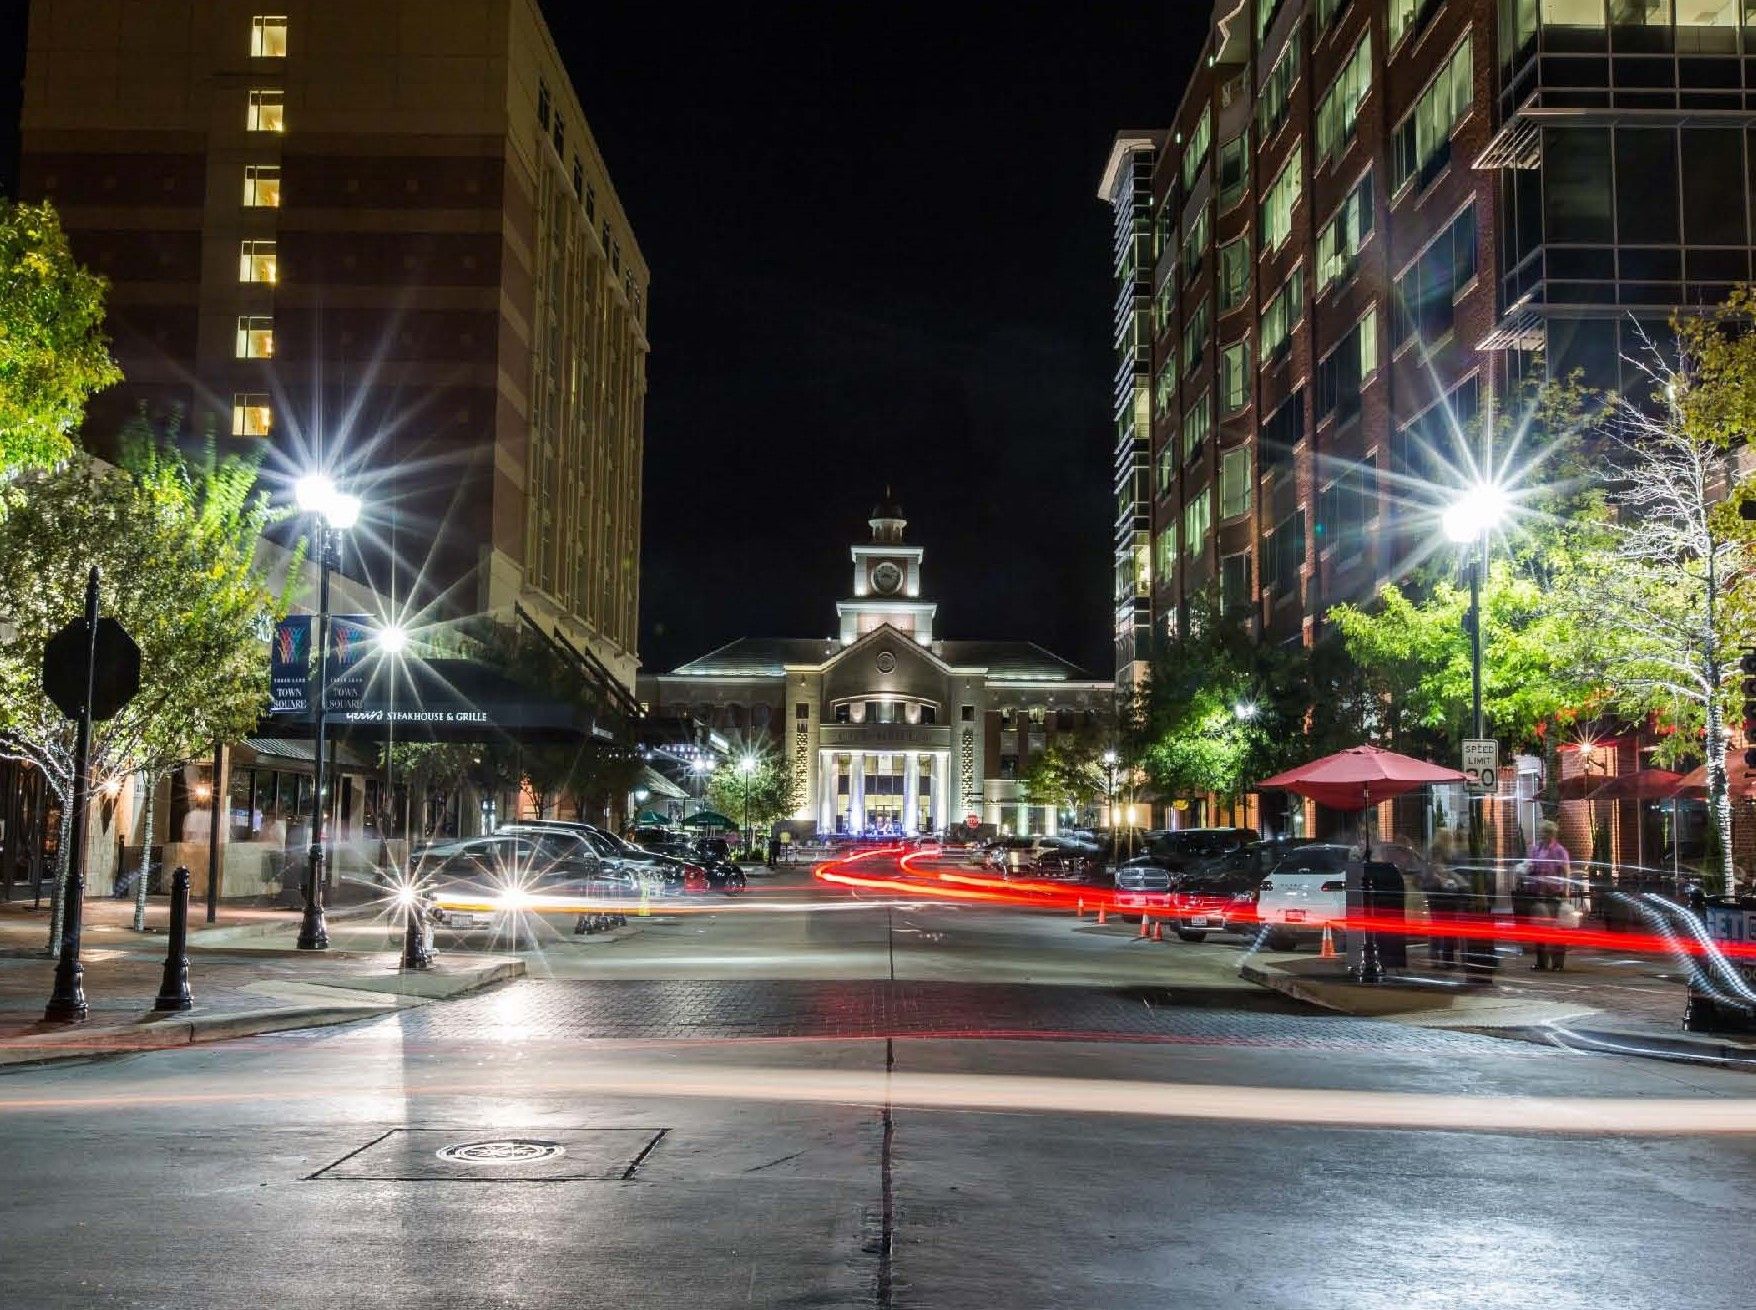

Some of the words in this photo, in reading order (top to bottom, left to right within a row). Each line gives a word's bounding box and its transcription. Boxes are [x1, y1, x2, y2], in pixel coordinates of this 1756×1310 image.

[276, 688, 302, 698] TOWN
[386, 712, 444, 722] STEAKHOUSE
[446, 712, 454, 721] &
[455, 712, 487, 722] GRILLE
[1465, 745, 1494, 754] SPEED
[1468, 757, 1491, 765] LIMIT
